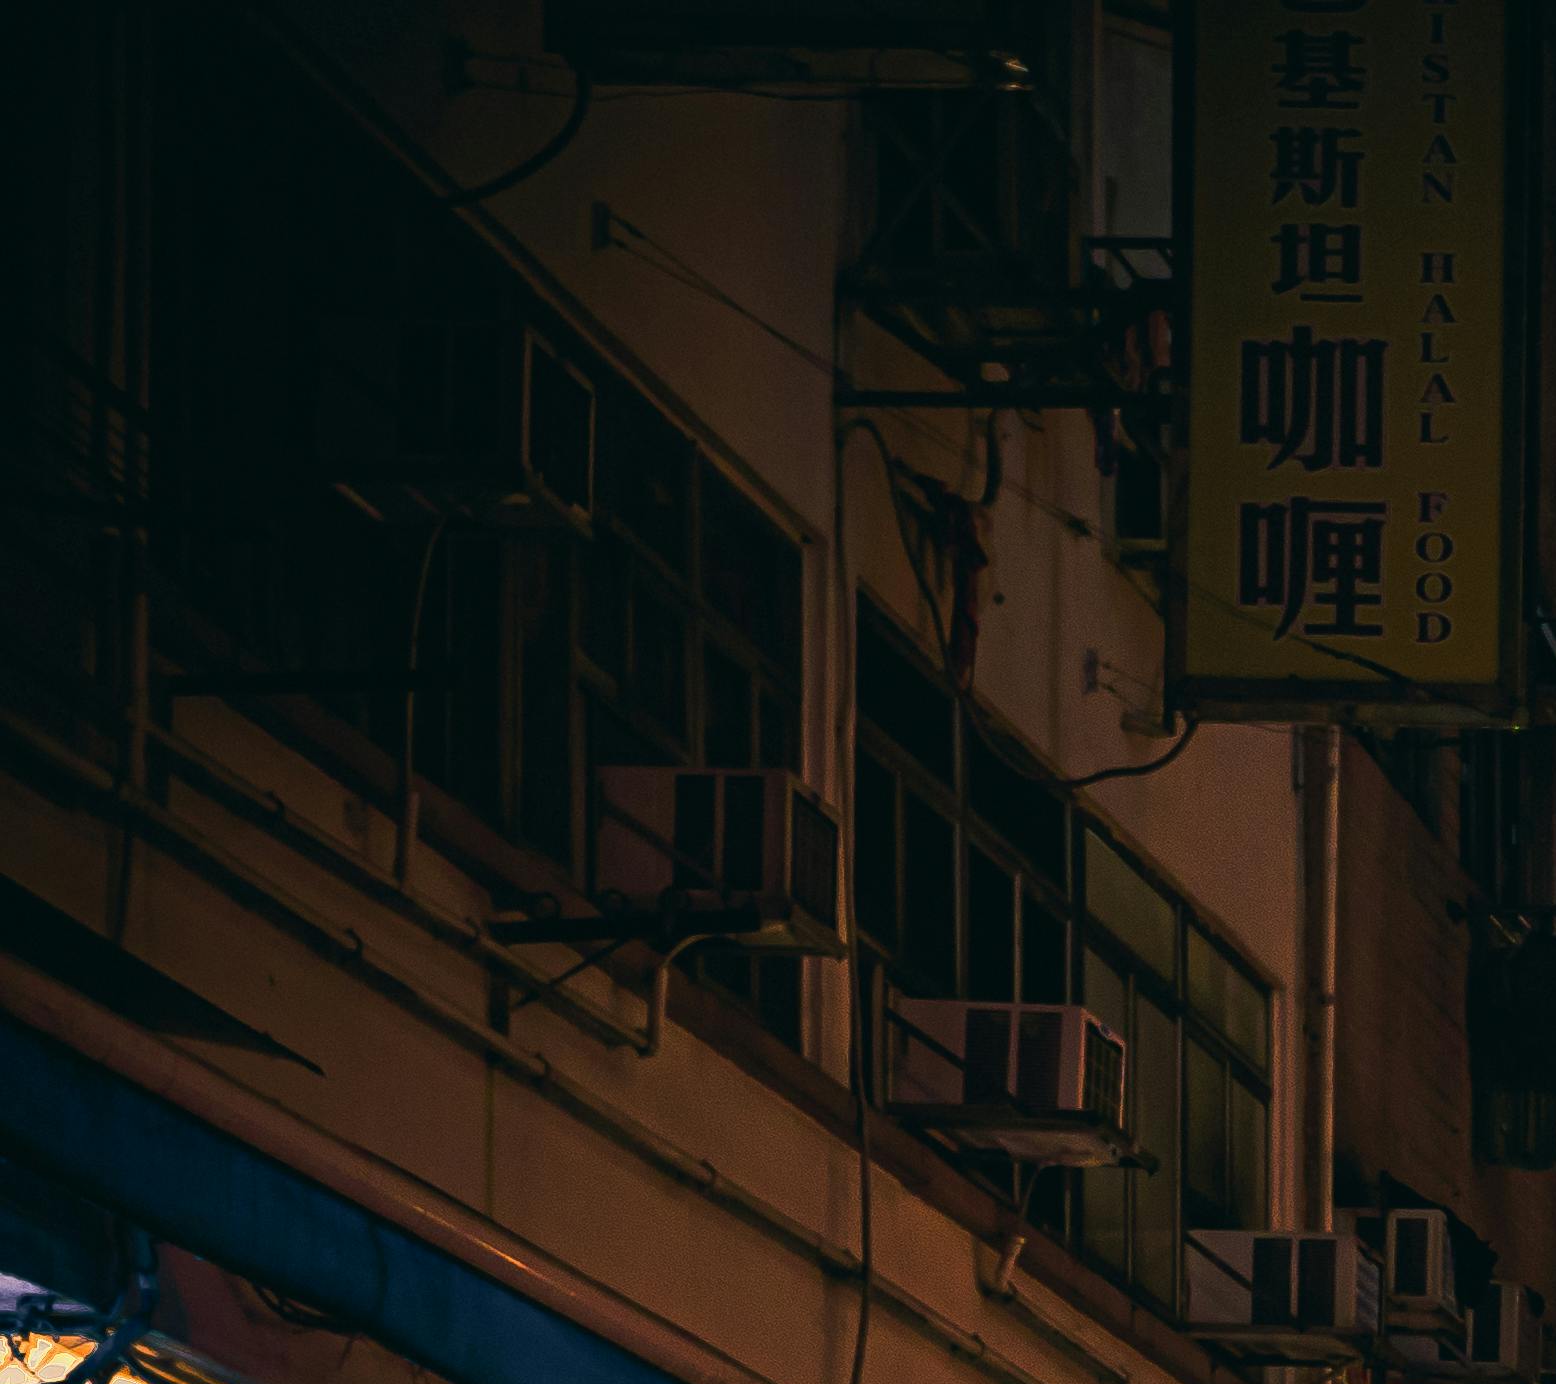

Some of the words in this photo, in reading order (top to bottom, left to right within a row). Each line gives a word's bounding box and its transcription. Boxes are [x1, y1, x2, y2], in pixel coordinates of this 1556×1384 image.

[1419, 0, 1458, 205] ISTAN
[1238, 0, 1391, 641] 基斯坦咖喱
[1419, 252, 1457, 445] HALAL
[1415, 491, 1456, 645] FOOD
